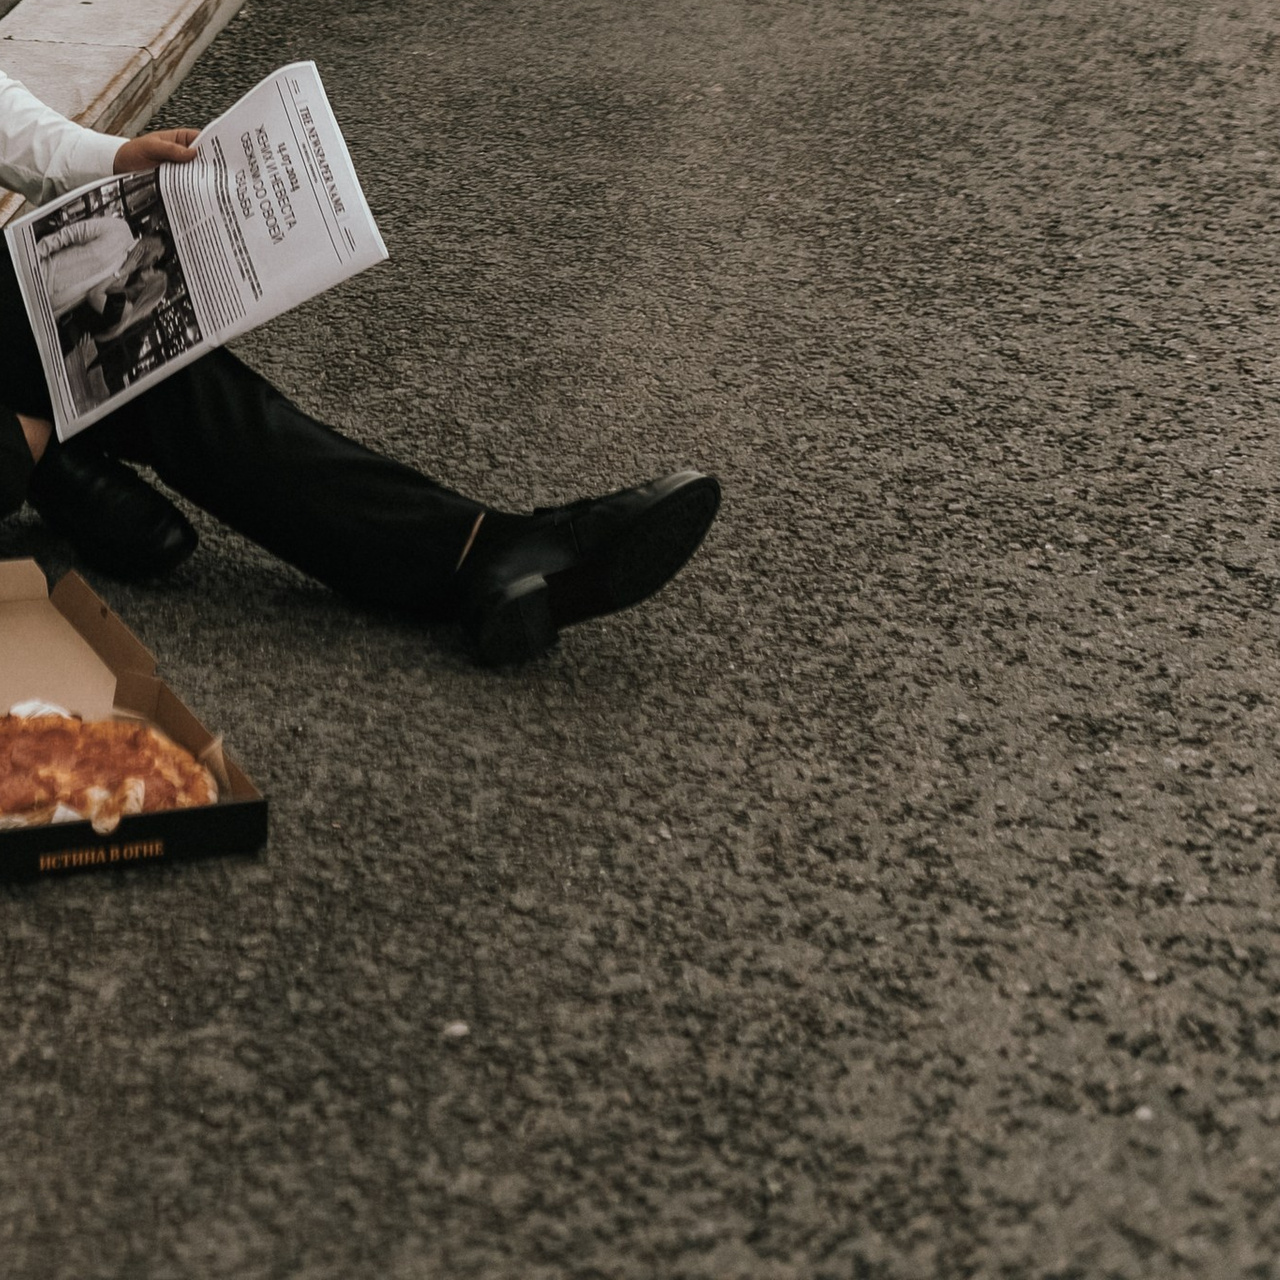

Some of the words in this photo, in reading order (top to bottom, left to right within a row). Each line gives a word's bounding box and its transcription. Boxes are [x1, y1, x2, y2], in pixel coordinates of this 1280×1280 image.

[298, 104, 313, 125] THE
[238, 131, 262, 182] СБЕЖАЛИ
[253, 123, 275, 163] ЖЕНИХ
[305, 125, 334, 184] NEWSPAPER
[264, 162, 277, 174] И
[275, 141, 301, 193] 14.07.2024
[231, 168, 255, 219] СВАДЬБЫ
[251, 179, 267, 200] СО
[267, 172, 298, 231] НЕВЕСТА
[326, 182, 345, 216] NAME
[257, 198, 286, 245] СВОЕЙ
[39, 848, 106, 871] ИСТИНА
[109, 845, 120, 861] В
[123, 841, 165, 860] ОГНЕ
